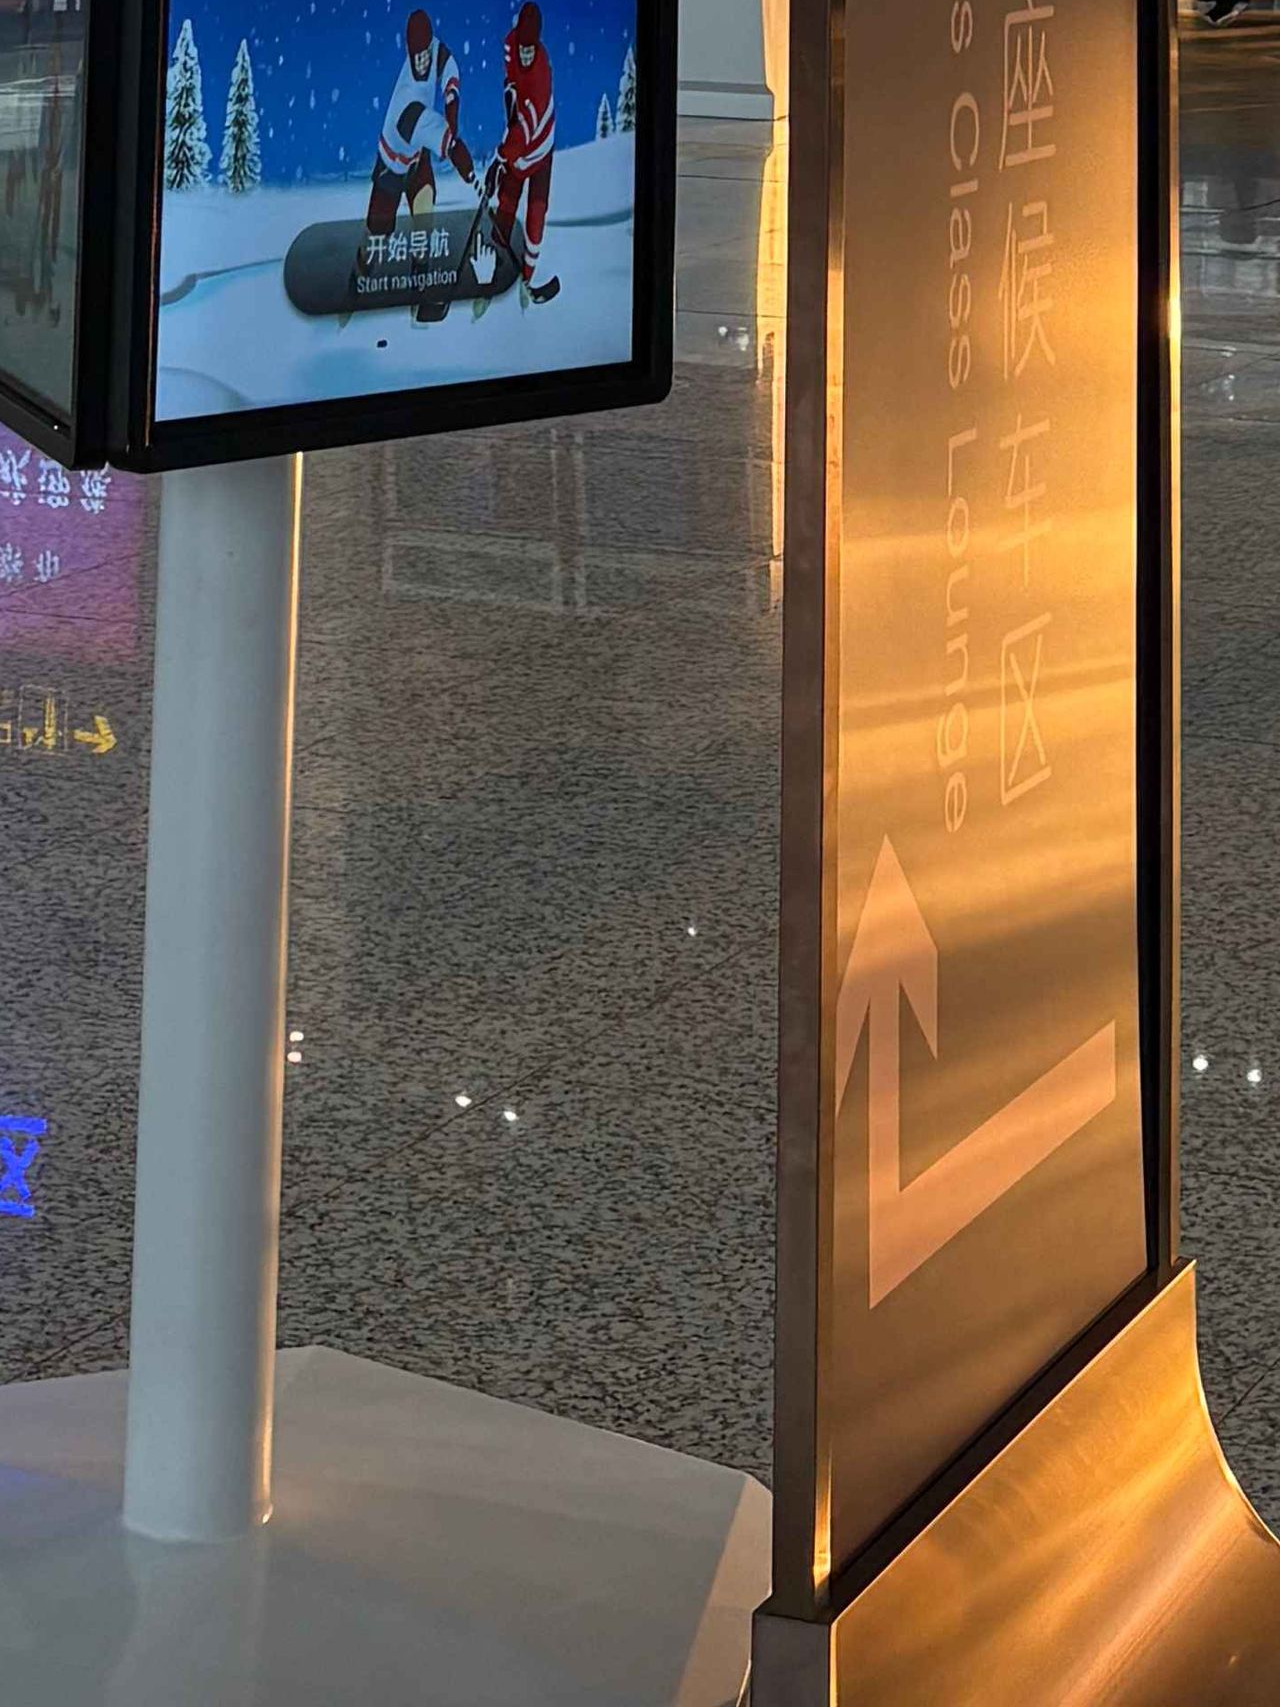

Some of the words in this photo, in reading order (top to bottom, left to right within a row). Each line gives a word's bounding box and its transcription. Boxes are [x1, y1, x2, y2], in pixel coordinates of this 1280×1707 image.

[356, 275, 389, 294] Start
[391, 268, 458, 292] navigation
[366, 227, 451, 265] 开始导航
[947, 91, 981, 388] Class
[937, 425, 980, 833] Lounge
